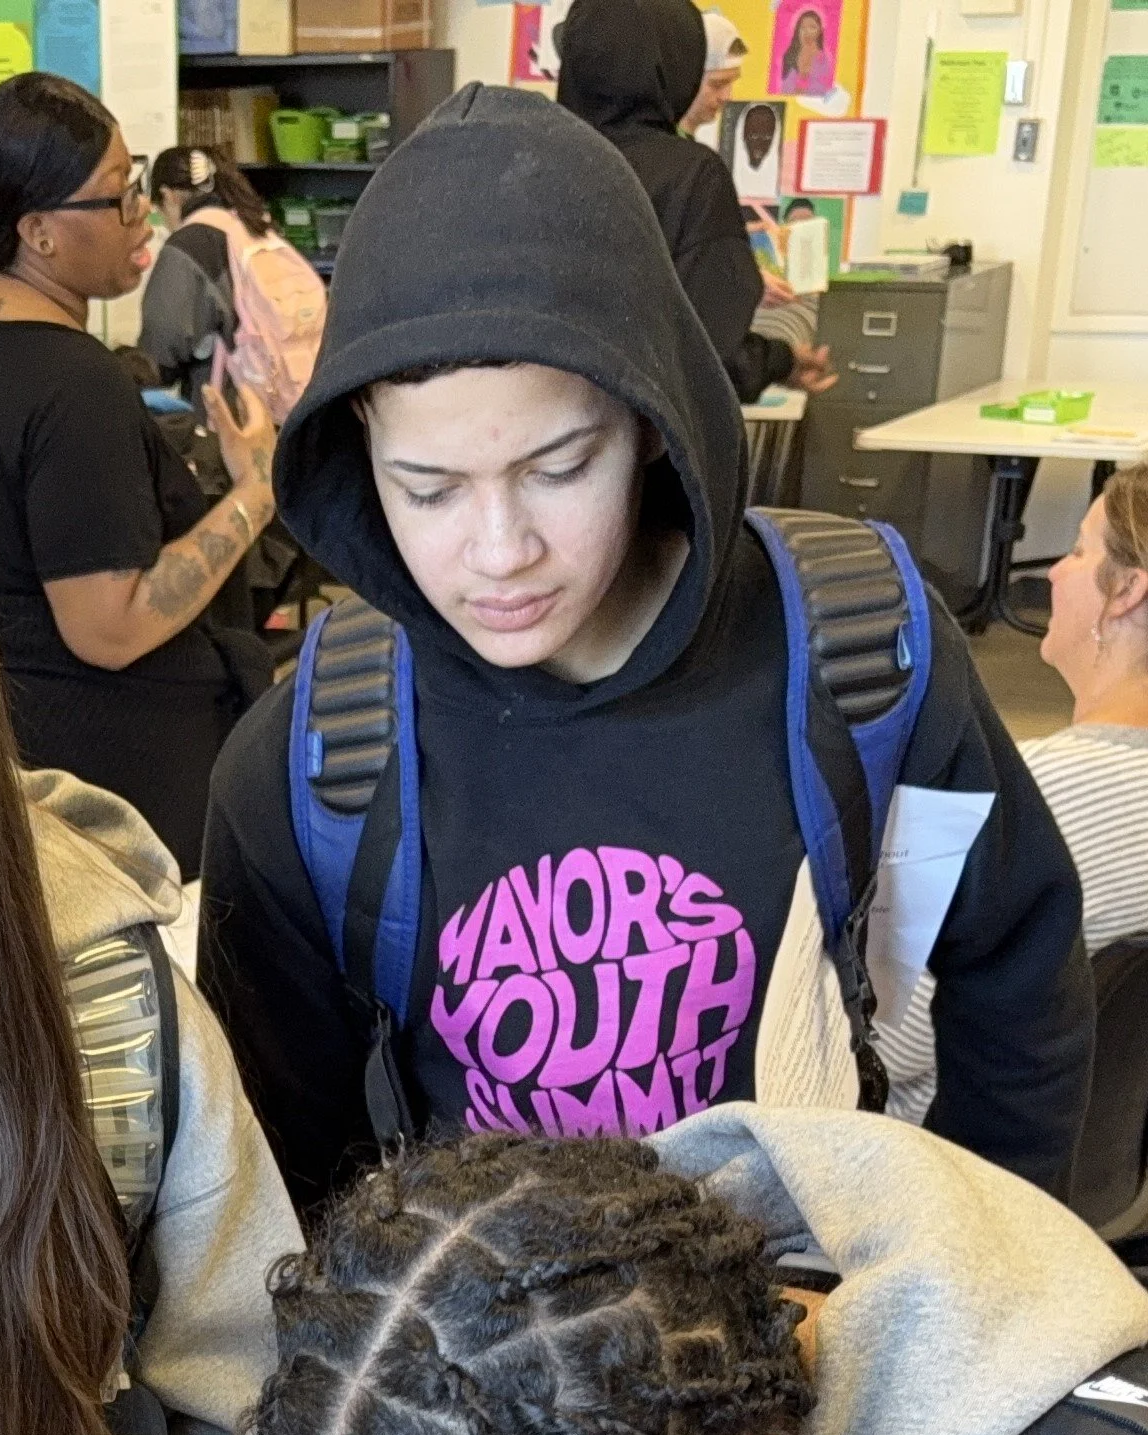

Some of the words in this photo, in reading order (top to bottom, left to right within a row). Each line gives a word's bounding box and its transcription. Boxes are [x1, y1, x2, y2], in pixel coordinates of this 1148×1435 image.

[439, 846, 743, 985] MAYOR'S
[430, 928, 756, 1088] YOUTH
[465, 1029, 740, 1137] SUMMIT
